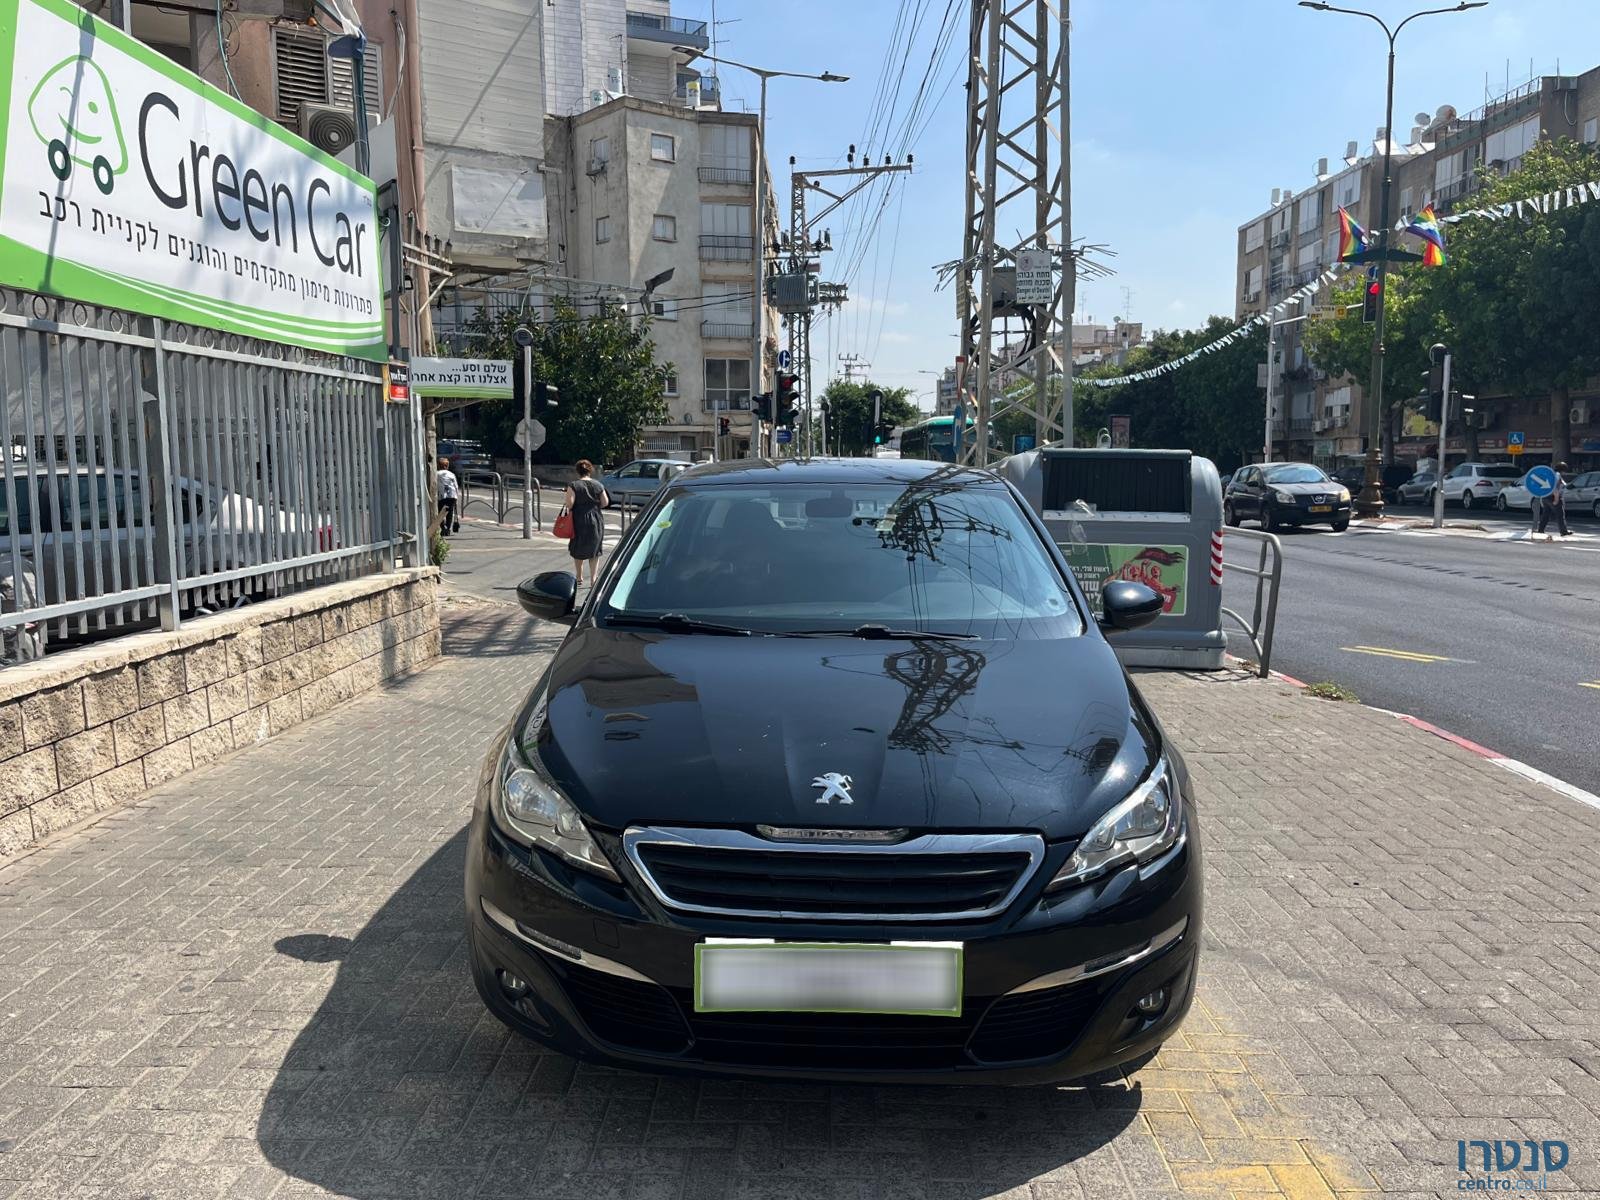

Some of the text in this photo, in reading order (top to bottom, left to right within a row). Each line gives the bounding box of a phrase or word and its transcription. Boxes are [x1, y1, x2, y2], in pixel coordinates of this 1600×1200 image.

[138, 92, 366, 278] Green Car
[38, 190, 373, 316] פתרונות מימון מתקדמים והוגנים לקניית רכב
[452, 363, 507, 373] שלם וסע...
[439, 373, 461, 385] קצת
[464, 373, 476, 383] זה
[479, 373, 507, 384] אצלנו
